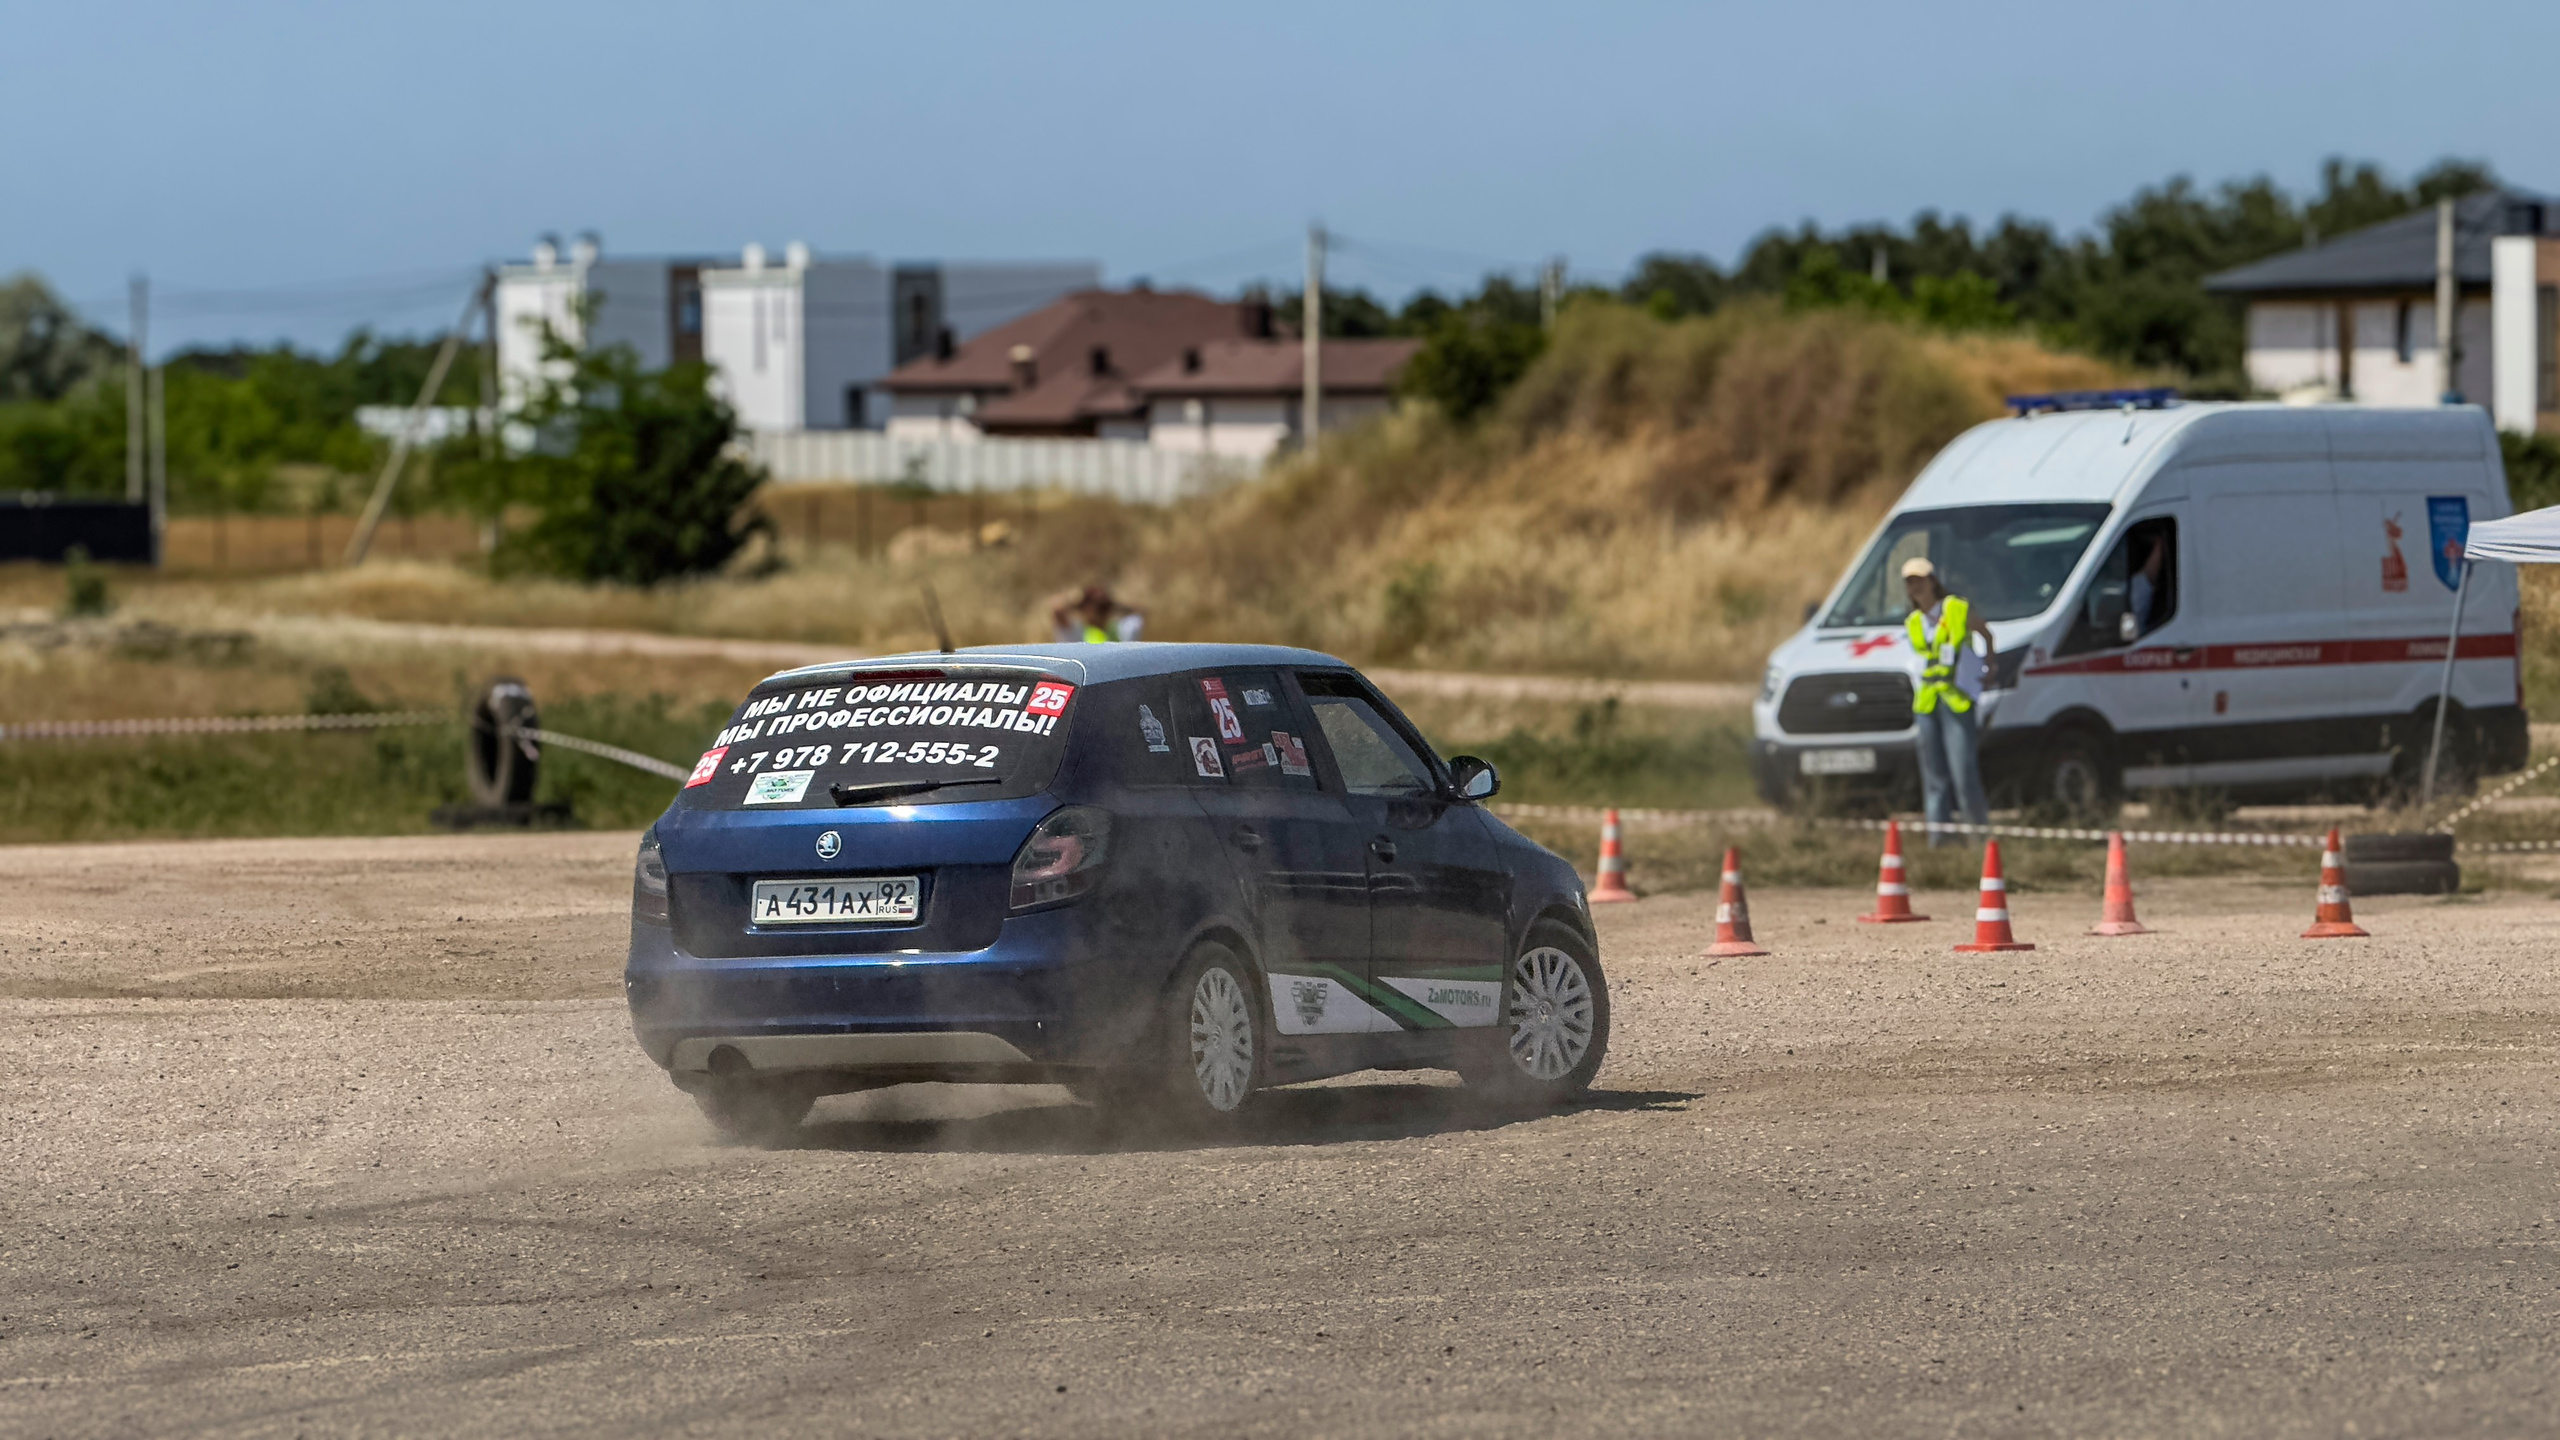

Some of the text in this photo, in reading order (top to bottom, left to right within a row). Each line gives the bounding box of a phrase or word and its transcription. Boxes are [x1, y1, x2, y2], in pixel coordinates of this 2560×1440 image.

[741, 682, 1029, 720] МЫ НЕ ОФИЦИАЛЫ
[1029, 687, 1069, 711] 25
[713, 705, 1058, 748] МЫ ПРОФЕССИОНАЛЫ!
[1210, 697, 1242, 739] 25
[695, 754, 720, 780] 25
[730, 741, 1000, 774] +7 978 712-555-2
[880, 883, 908, 905] 92
[878, 906, 898, 914] RUS
[1428, 987, 1492, 1008] ZaMOTORS.ru
